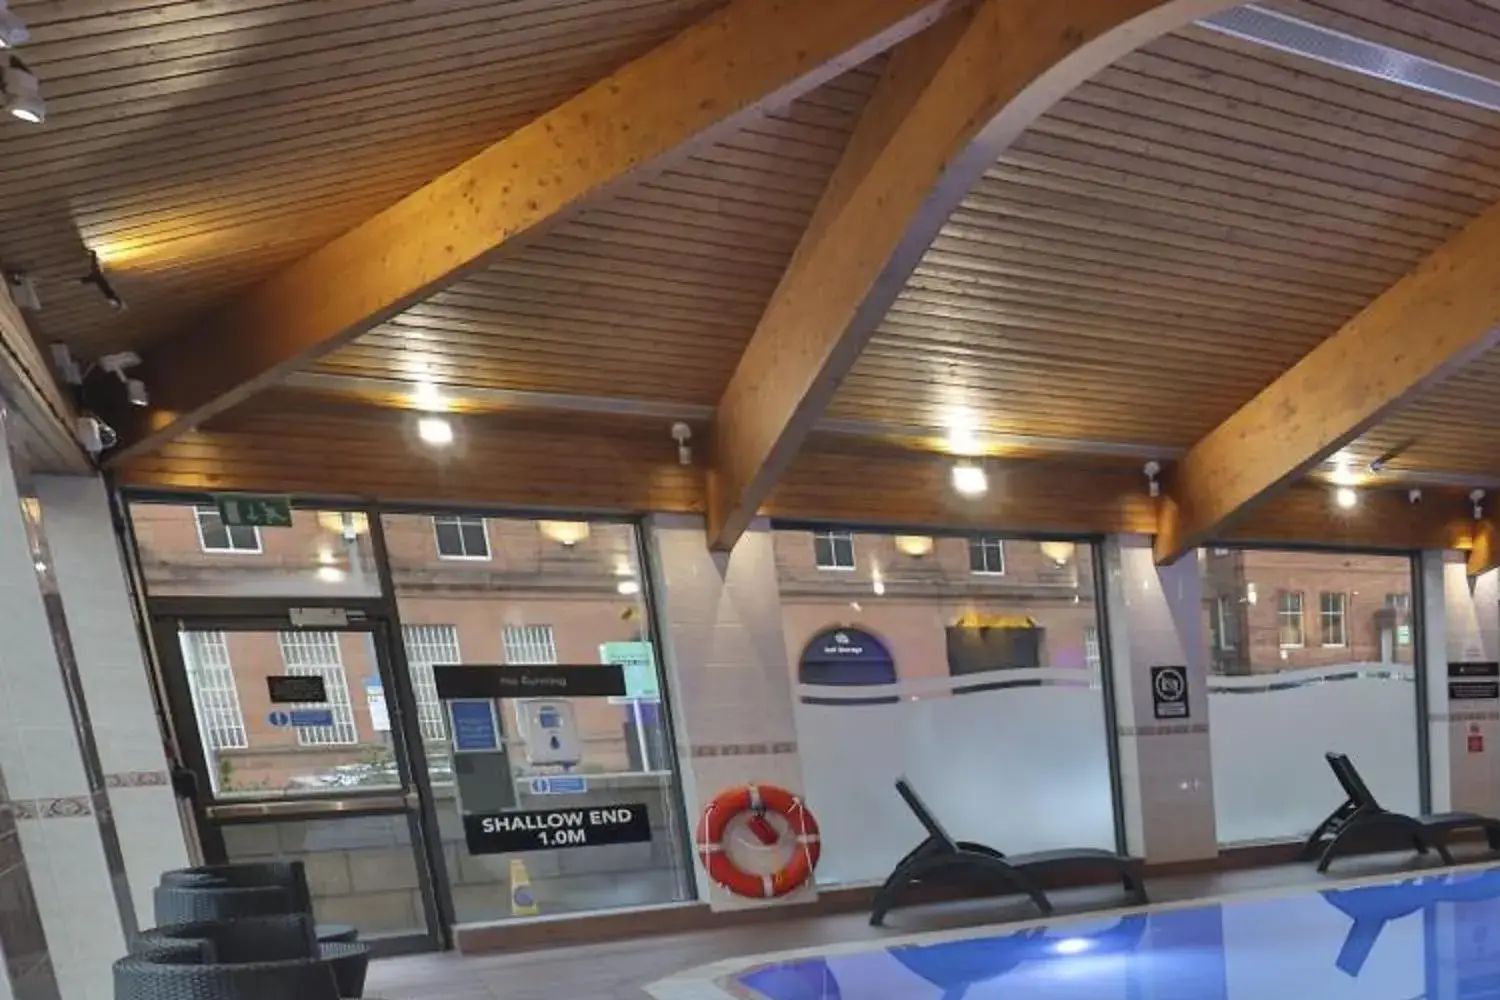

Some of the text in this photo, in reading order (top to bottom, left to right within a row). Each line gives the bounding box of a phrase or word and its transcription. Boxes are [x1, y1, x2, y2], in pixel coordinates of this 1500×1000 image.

[481, 809, 632, 833] SHALLOW END
[537, 829, 586, 846] 1.0M
